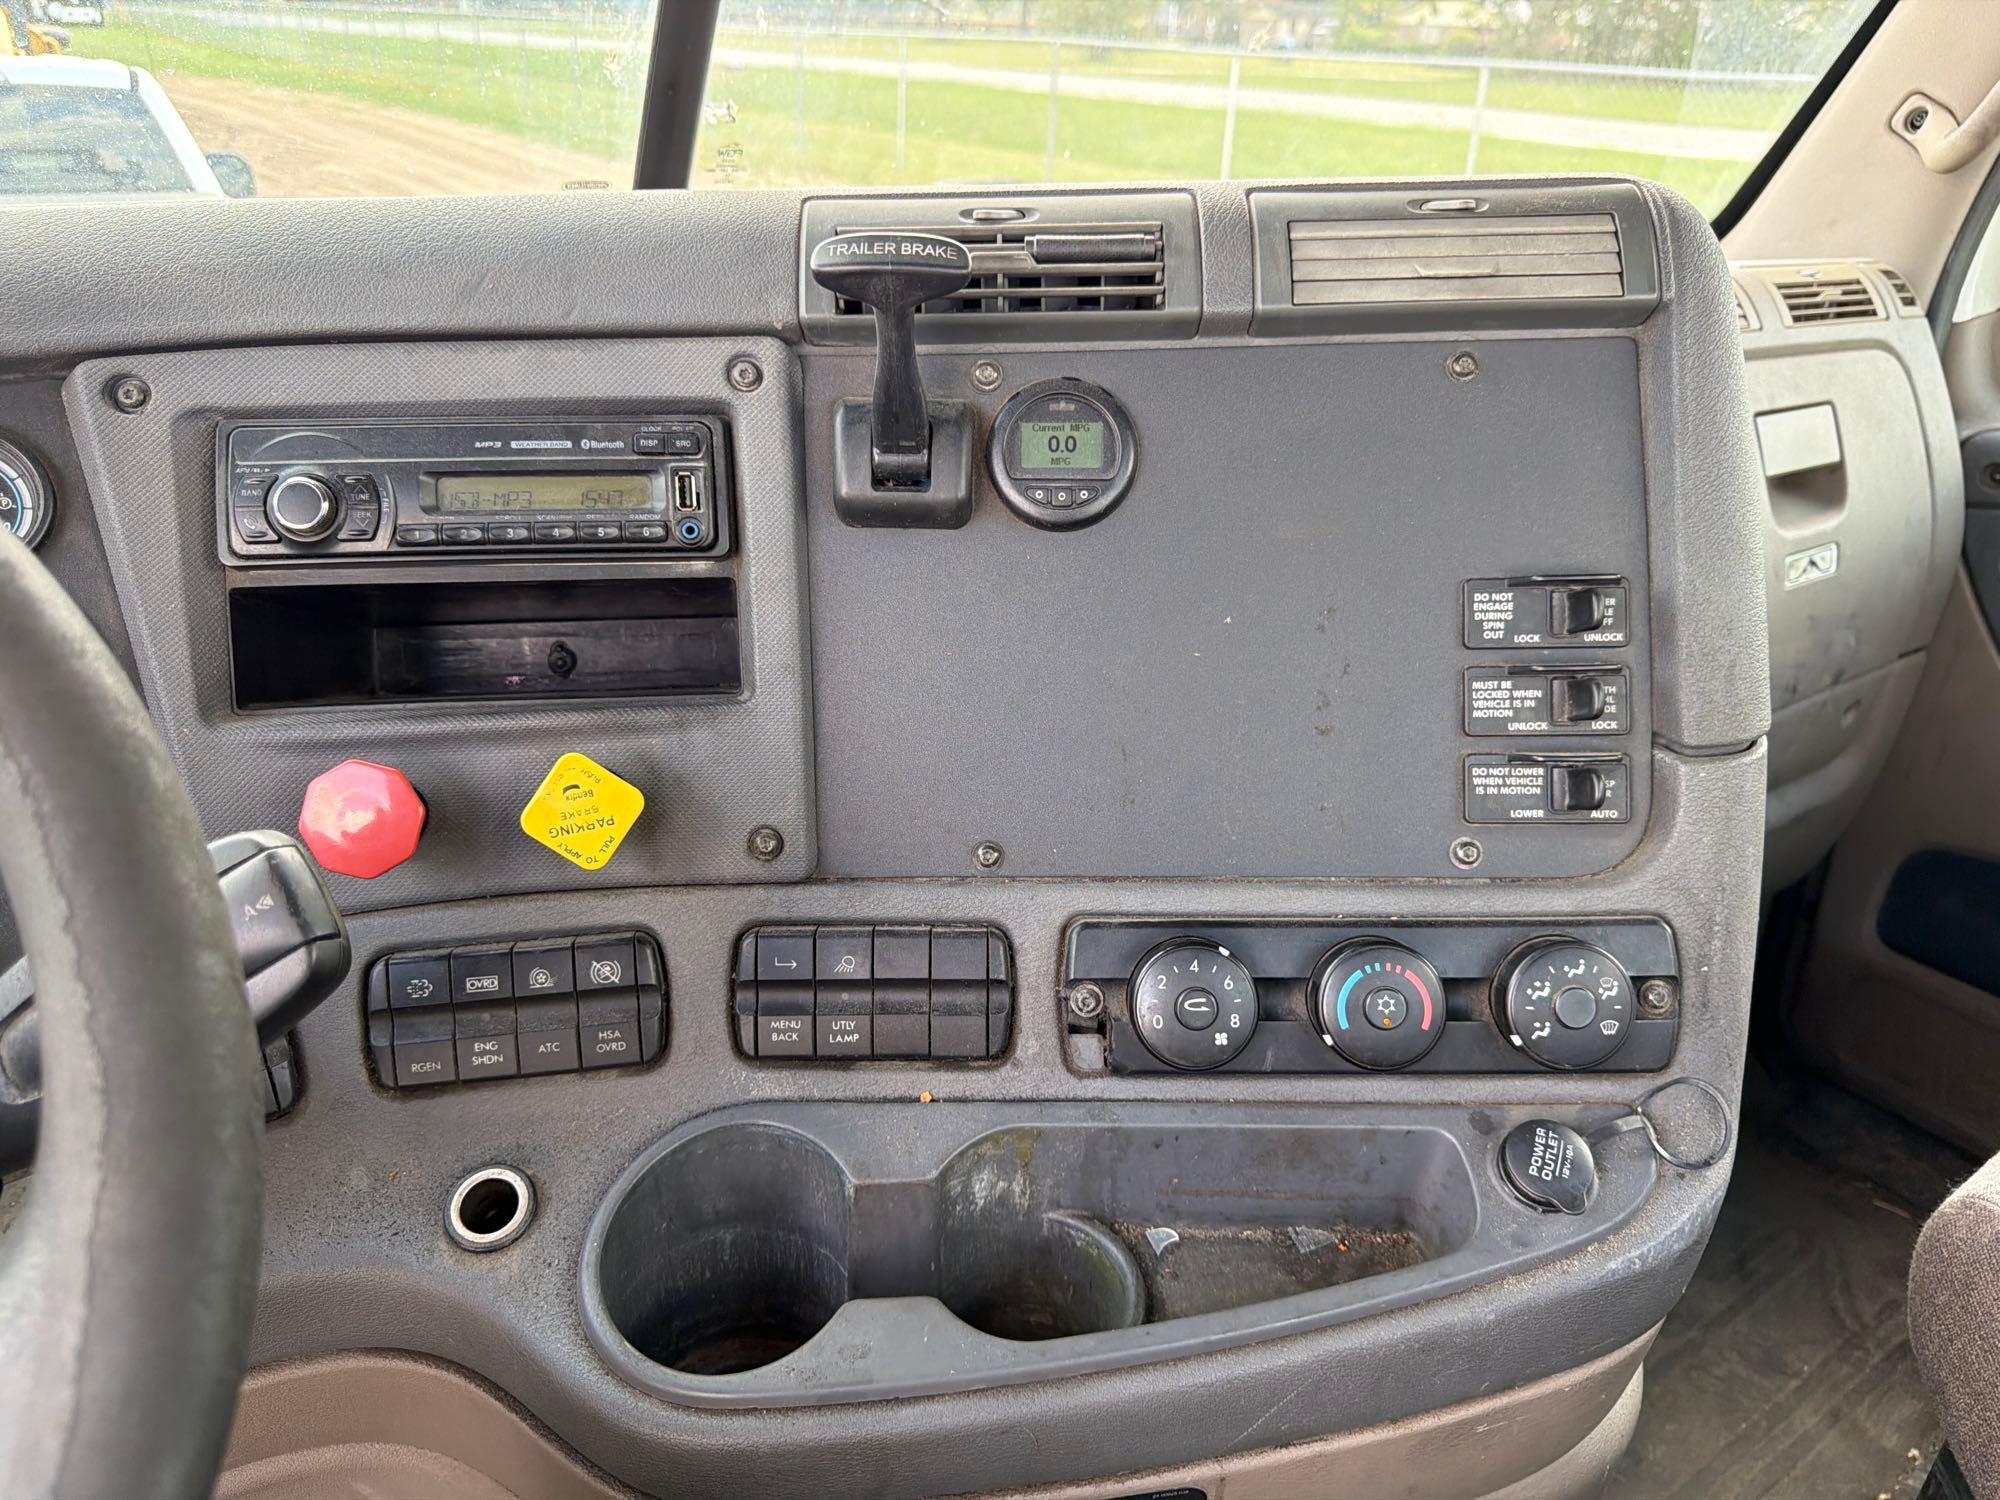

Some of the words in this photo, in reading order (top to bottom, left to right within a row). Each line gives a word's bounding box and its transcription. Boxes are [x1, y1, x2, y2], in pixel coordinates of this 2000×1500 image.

[827, 242, 896, 257] TRAILER
[901, 242, 958, 260] BRAKE
[1032, 423, 1065, 432] Current
[1069, 423, 1090, 432] MPG
[590, 440, 625, 449] Bluetooth
[675, 440, 692, 448] SRC
[1048, 435, 1077, 453] 0.0
[1050, 457, 1071, 466] MPG
[240, 489, 263, 497] BAND
[351, 493, 371, 501] TUNE
[352, 511, 372, 519] SEEK
[415, 530, 420, 539] 1
[460, 529, 468, 537] 2
[506, 528, 514, 537] 3
[552, 528, 560, 537] 4
[597, 527, 605, 537] 5
[642, 527, 650, 537] 6
[1474, 592, 1490, 601] DO
[1491, 592, 1514, 601] NOT
[1473, 602, 1514, 611] ENGAGE
[1474, 611, 1513, 620] DURING
[1482, 621, 1504, 630] SPIN
[1483, 630, 1504, 639] OUT
[1514, 634, 1540, 643] LOCK
[1584, 633, 1623, 642] UNLOCK
[1472, 681, 1499, 689] MUST
[1500, 681, 1512, 689] BE
[1473, 690, 1511, 699] LOCKED
[1512, 689, 1542, 698] WHEN
[1473, 700, 1511, 708] VEHICLE
[1512, 700, 1522, 708] IS
[1473, 709, 1513, 717] MOTION
[1508, 722, 1548, 731] UNLOCK
[1592, 721, 1618, 729] LOCK
[1472, 767, 1488, 776] DO
[1488, 767, 1510, 776] NOT
[1511, 768, 1544, 776] LOWER
[1473, 777, 1503, 786] WHEN
[1504, 777, 1544, 785] VEHICLE
[565, 789, 594, 801] Bendix
[1475, 786, 1485, 795] IS
[1486, 786, 1498, 795] IN
[1500, 786, 1541, 795] MOTION
[560, 805, 599, 820] BRAKE
[1510, 809, 1544, 818] LOWER
[1590, 810, 1618, 818] AUTO
[549, 815, 615, 838] PARKING
[599, 836, 615, 853] PULL
[557, 842, 583, 859] APPLY
[585, 856, 598, 864] TO
[1189, 959, 1199, 974] 4
[467, 978, 497, 990] OVRD
[1158, 975, 1167, 990] 2
[1224, 975, 1234, 991] 6
[770, 1020, 801, 1029] MENU
[832, 1020, 856, 1030] UTLY
[1153, 1014, 1163, 1030] 0
[1230, 1013, 1240, 1029] 8
[598, 1030, 622, 1040] HSA
[771, 1032, 799, 1041] BACK
[829, 1033, 860, 1043] LAMP
[474, 1041, 498, 1051] ENG
[538, 1042, 560, 1053] ATC
[596, 1041, 626, 1053] OVRD
[472, 1054, 504, 1065] SHDN
[411, 1061, 441, 1073] RGEN
[1528, 1127, 1547, 1177] POWER
[1541, 1131, 1559, 1181] OUTLET
[1561, 1144, 1574, 1179] 12V-10A
